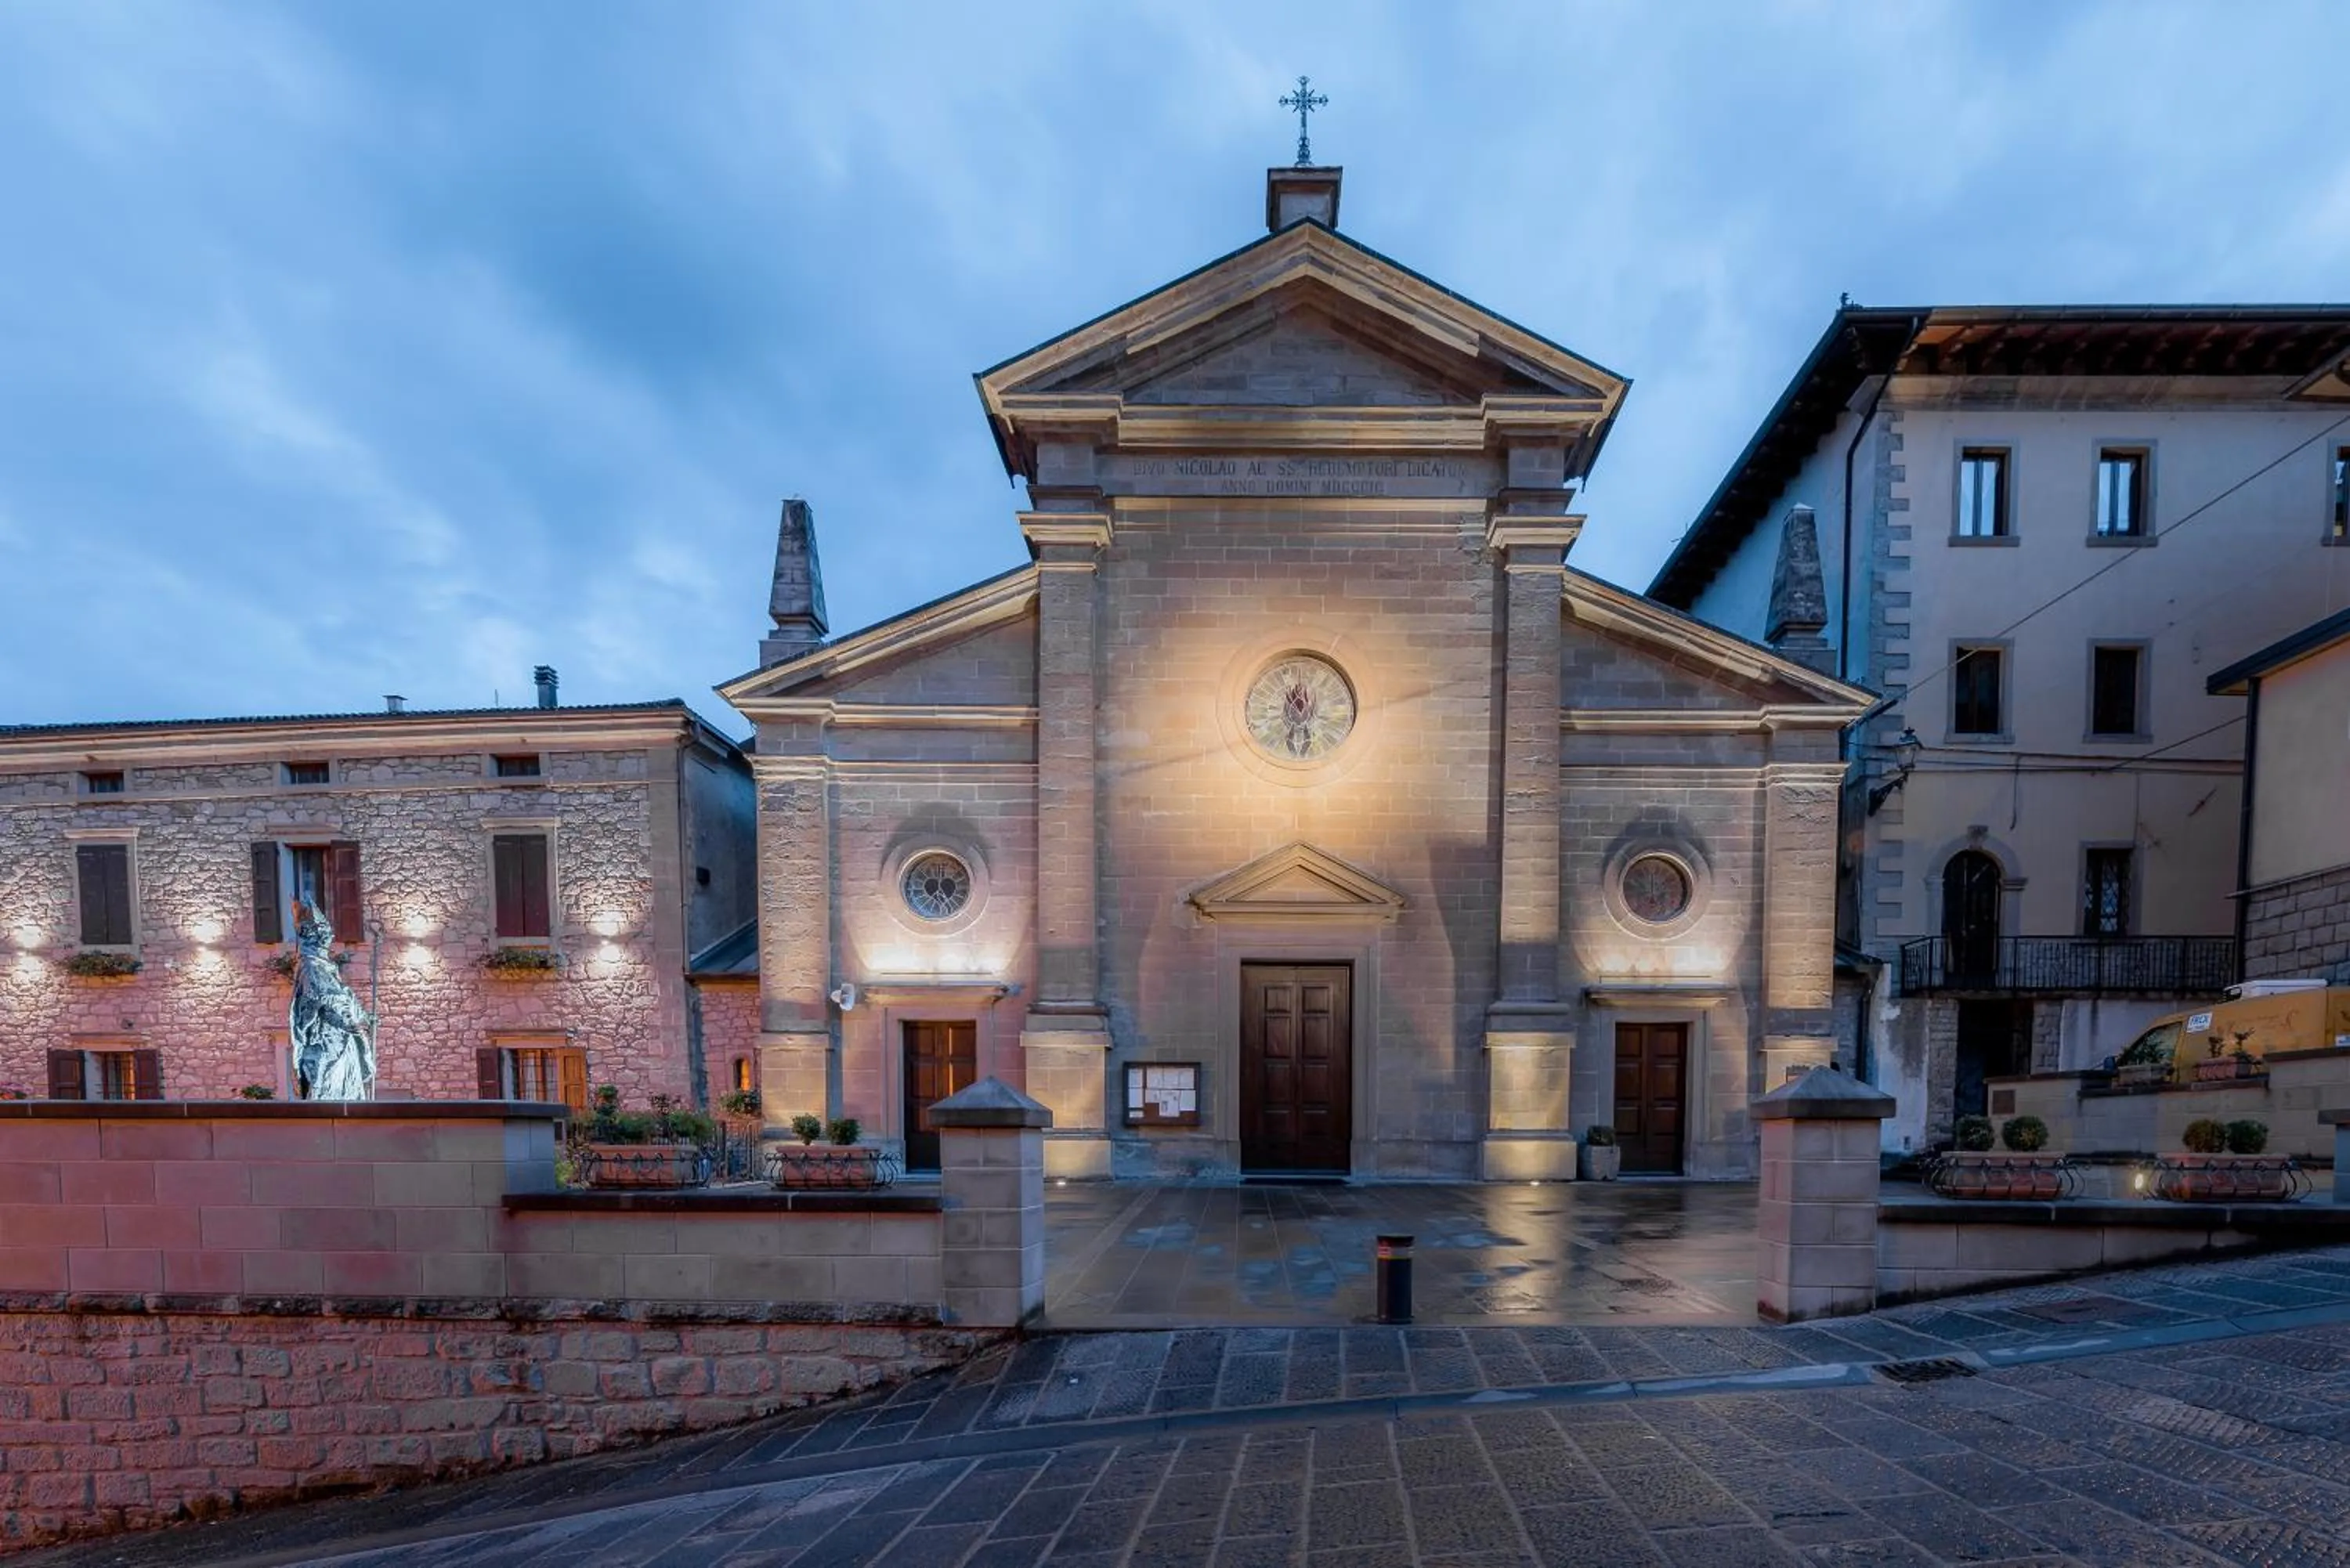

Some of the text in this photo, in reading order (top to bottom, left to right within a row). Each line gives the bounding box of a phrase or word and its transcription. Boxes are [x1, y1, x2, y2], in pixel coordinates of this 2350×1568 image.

[1175, 459, 1235, 476] NICOLAO
[1222, 479, 1256, 493] ANNO
[1267, 479, 1311, 493] DOMINI
